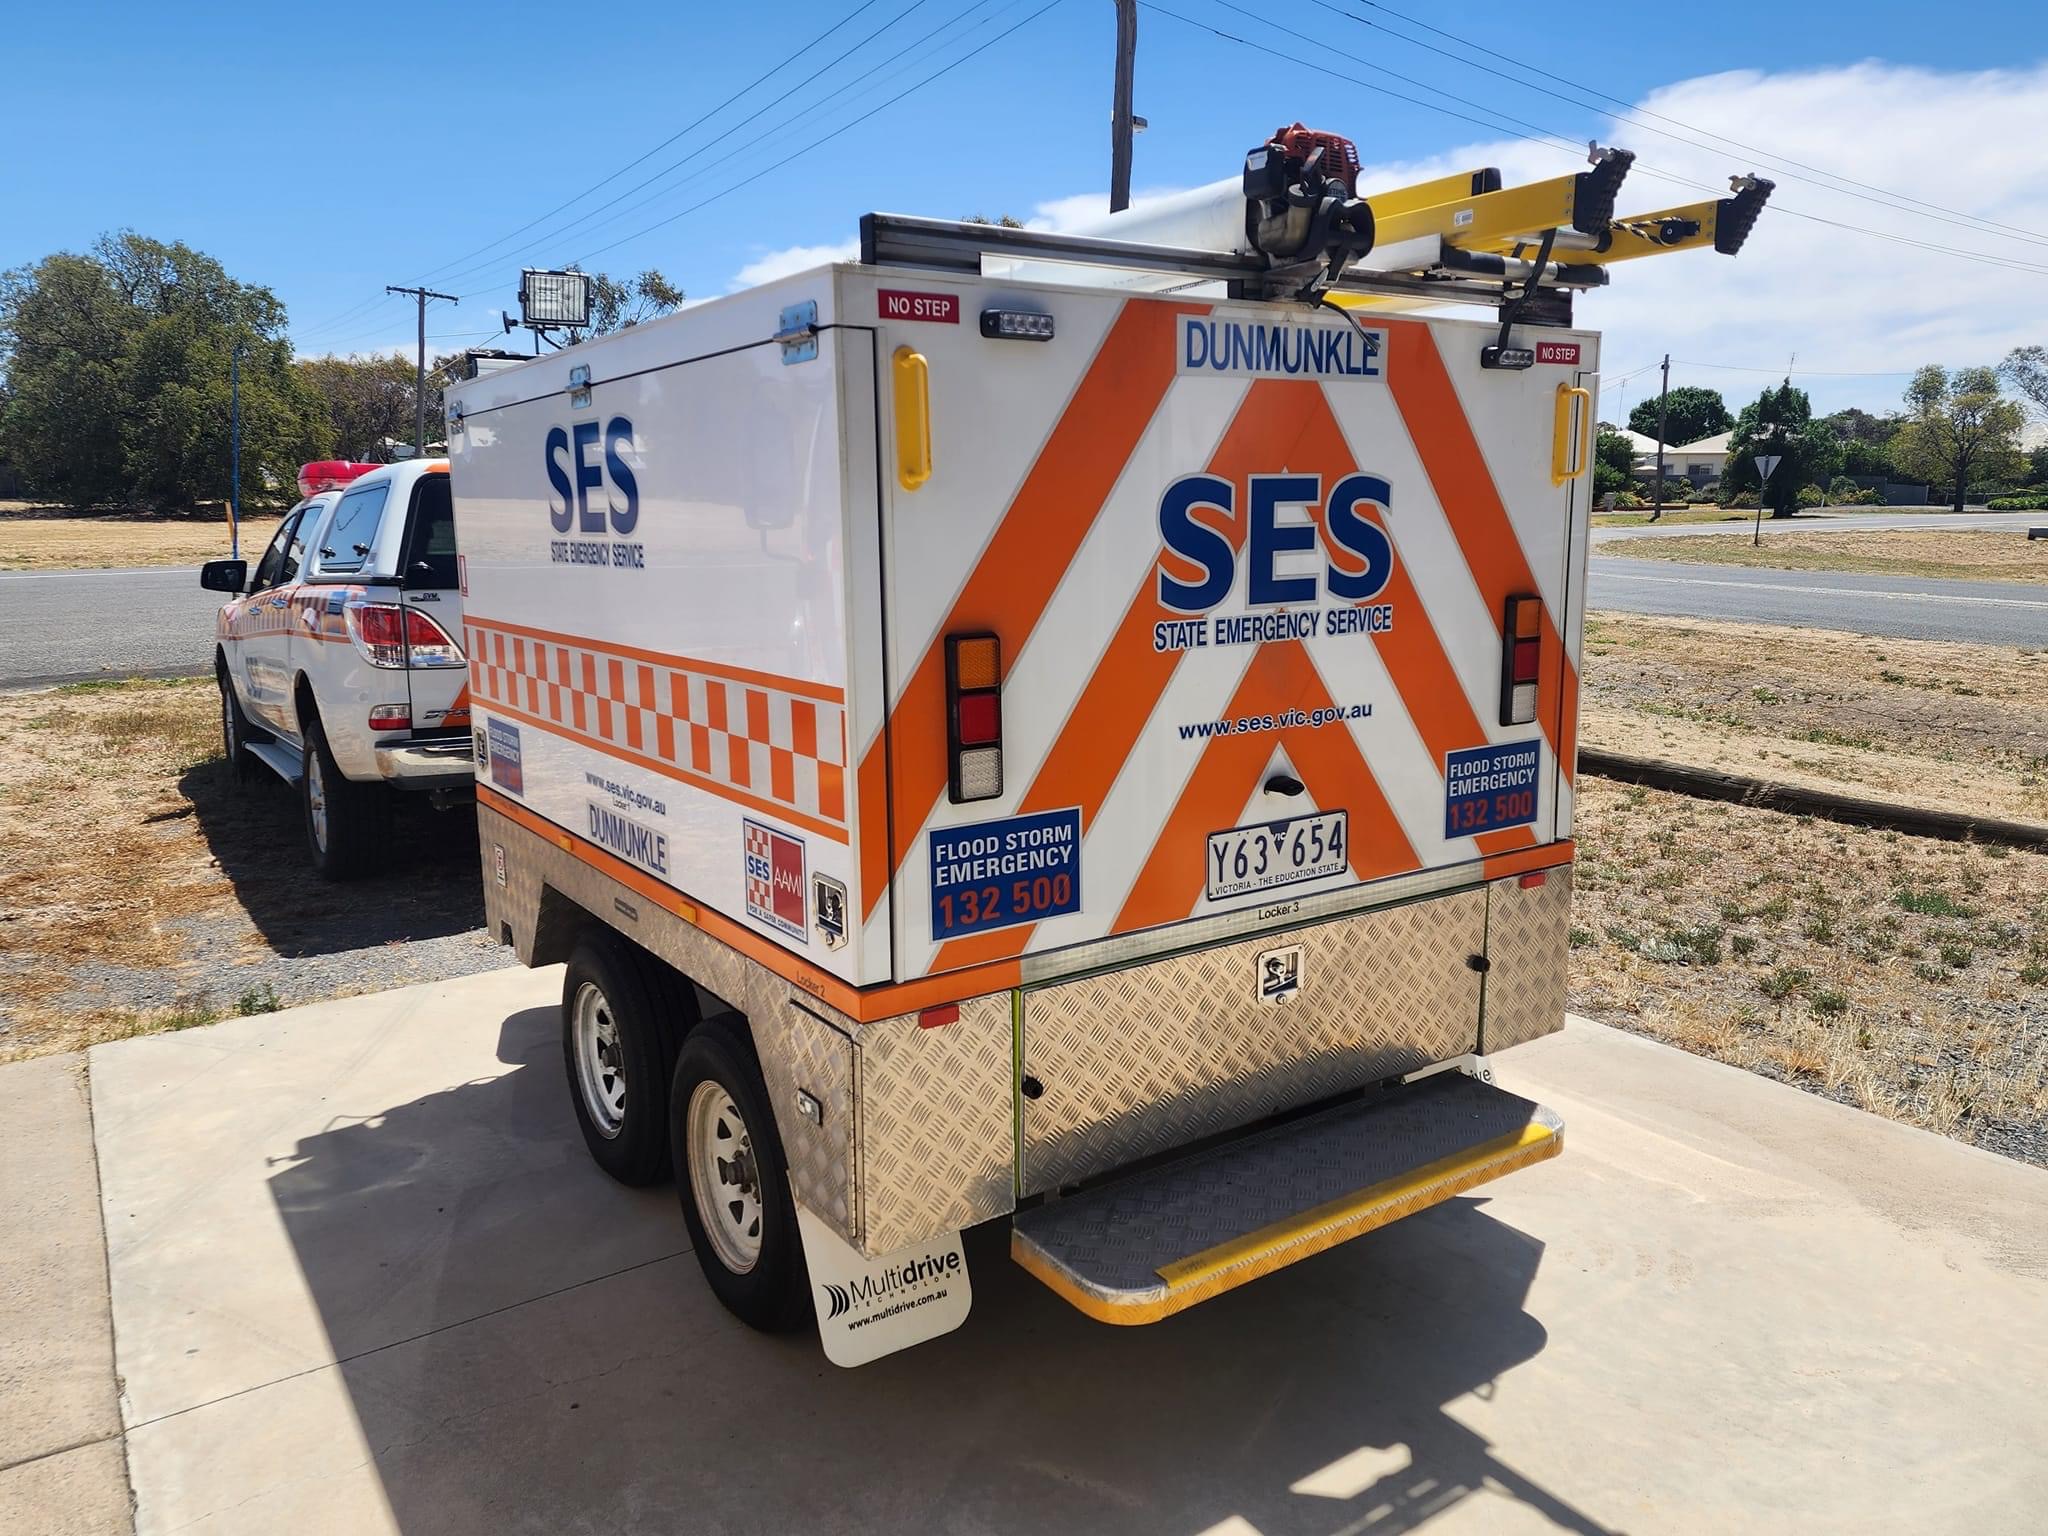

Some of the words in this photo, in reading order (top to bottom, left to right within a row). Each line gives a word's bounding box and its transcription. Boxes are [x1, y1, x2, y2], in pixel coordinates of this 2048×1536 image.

[888, 296, 910, 314] NO
[914, 298, 950, 317] STEP
[1186, 320, 1380, 376] DUNMUNKLE
[1542, 347, 1554, 360] NO
[1555, 348, 1576, 360] STEP
[545, 416, 639, 535] SES
[551, 541, 569, 562] STATE
[570, 542, 610, 566] EMERGENCY
[612, 543, 644, 568] SERVICE
[1159, 476, 1392, 611] SES
[1154, 622, 1208, 651] STATE
[1215, 612, 1320, 645] EMERGENCY
[1326, 606, 1393, 636] SERVICE
[1179, 703, 1373, 739] www.ses.vic.gov.au
[1449, 768, 1535, 797] EMERGENCY
[1450, 759, 1490, 779] FLOOD
[1493, 752, 1535, 771] STORM
[585, 772, 666, 816] www.ses.vic.gov.au
[1450, 799, 1488, 831] 132
[1495, 790, 1532, 822] 500
[589, 804, 666, 875] DUNMUNKLE
[935, 836, 999, 863] FLOOD
[1005, 824, 1072, 851] STORM
[1213, 834, 1269, 883] Y63
[1292, 820, 1343, 867] 654
[748, 855, 770, 881] SES
[774, 866, 802, 897] AAMI
[935, 845, 1073, 887] EMERGENCY
[1215, 883, 1252, 895] VICTORIA
[1259, 877, 1273, 886] THE
[1275, 868, 1317, 883] EDUCATION
[1318, 862, 1339, 873] STATE
[939, 886, 1000, 929] 132
[1012, 873, 1072, 914] 500
[1258, 905, 1291, 921] Locker
[1293, 902, 1300, 912] 3
[796, 970, 819, 992] Locker
[821, 988, 826, 998] 2
[850, 1251, 960, 1303] Multidrive
[855, 1269, 961, 1311] TECHNOLOGY
[848, 1289, 948, 1331] www.multidrive.com.au
